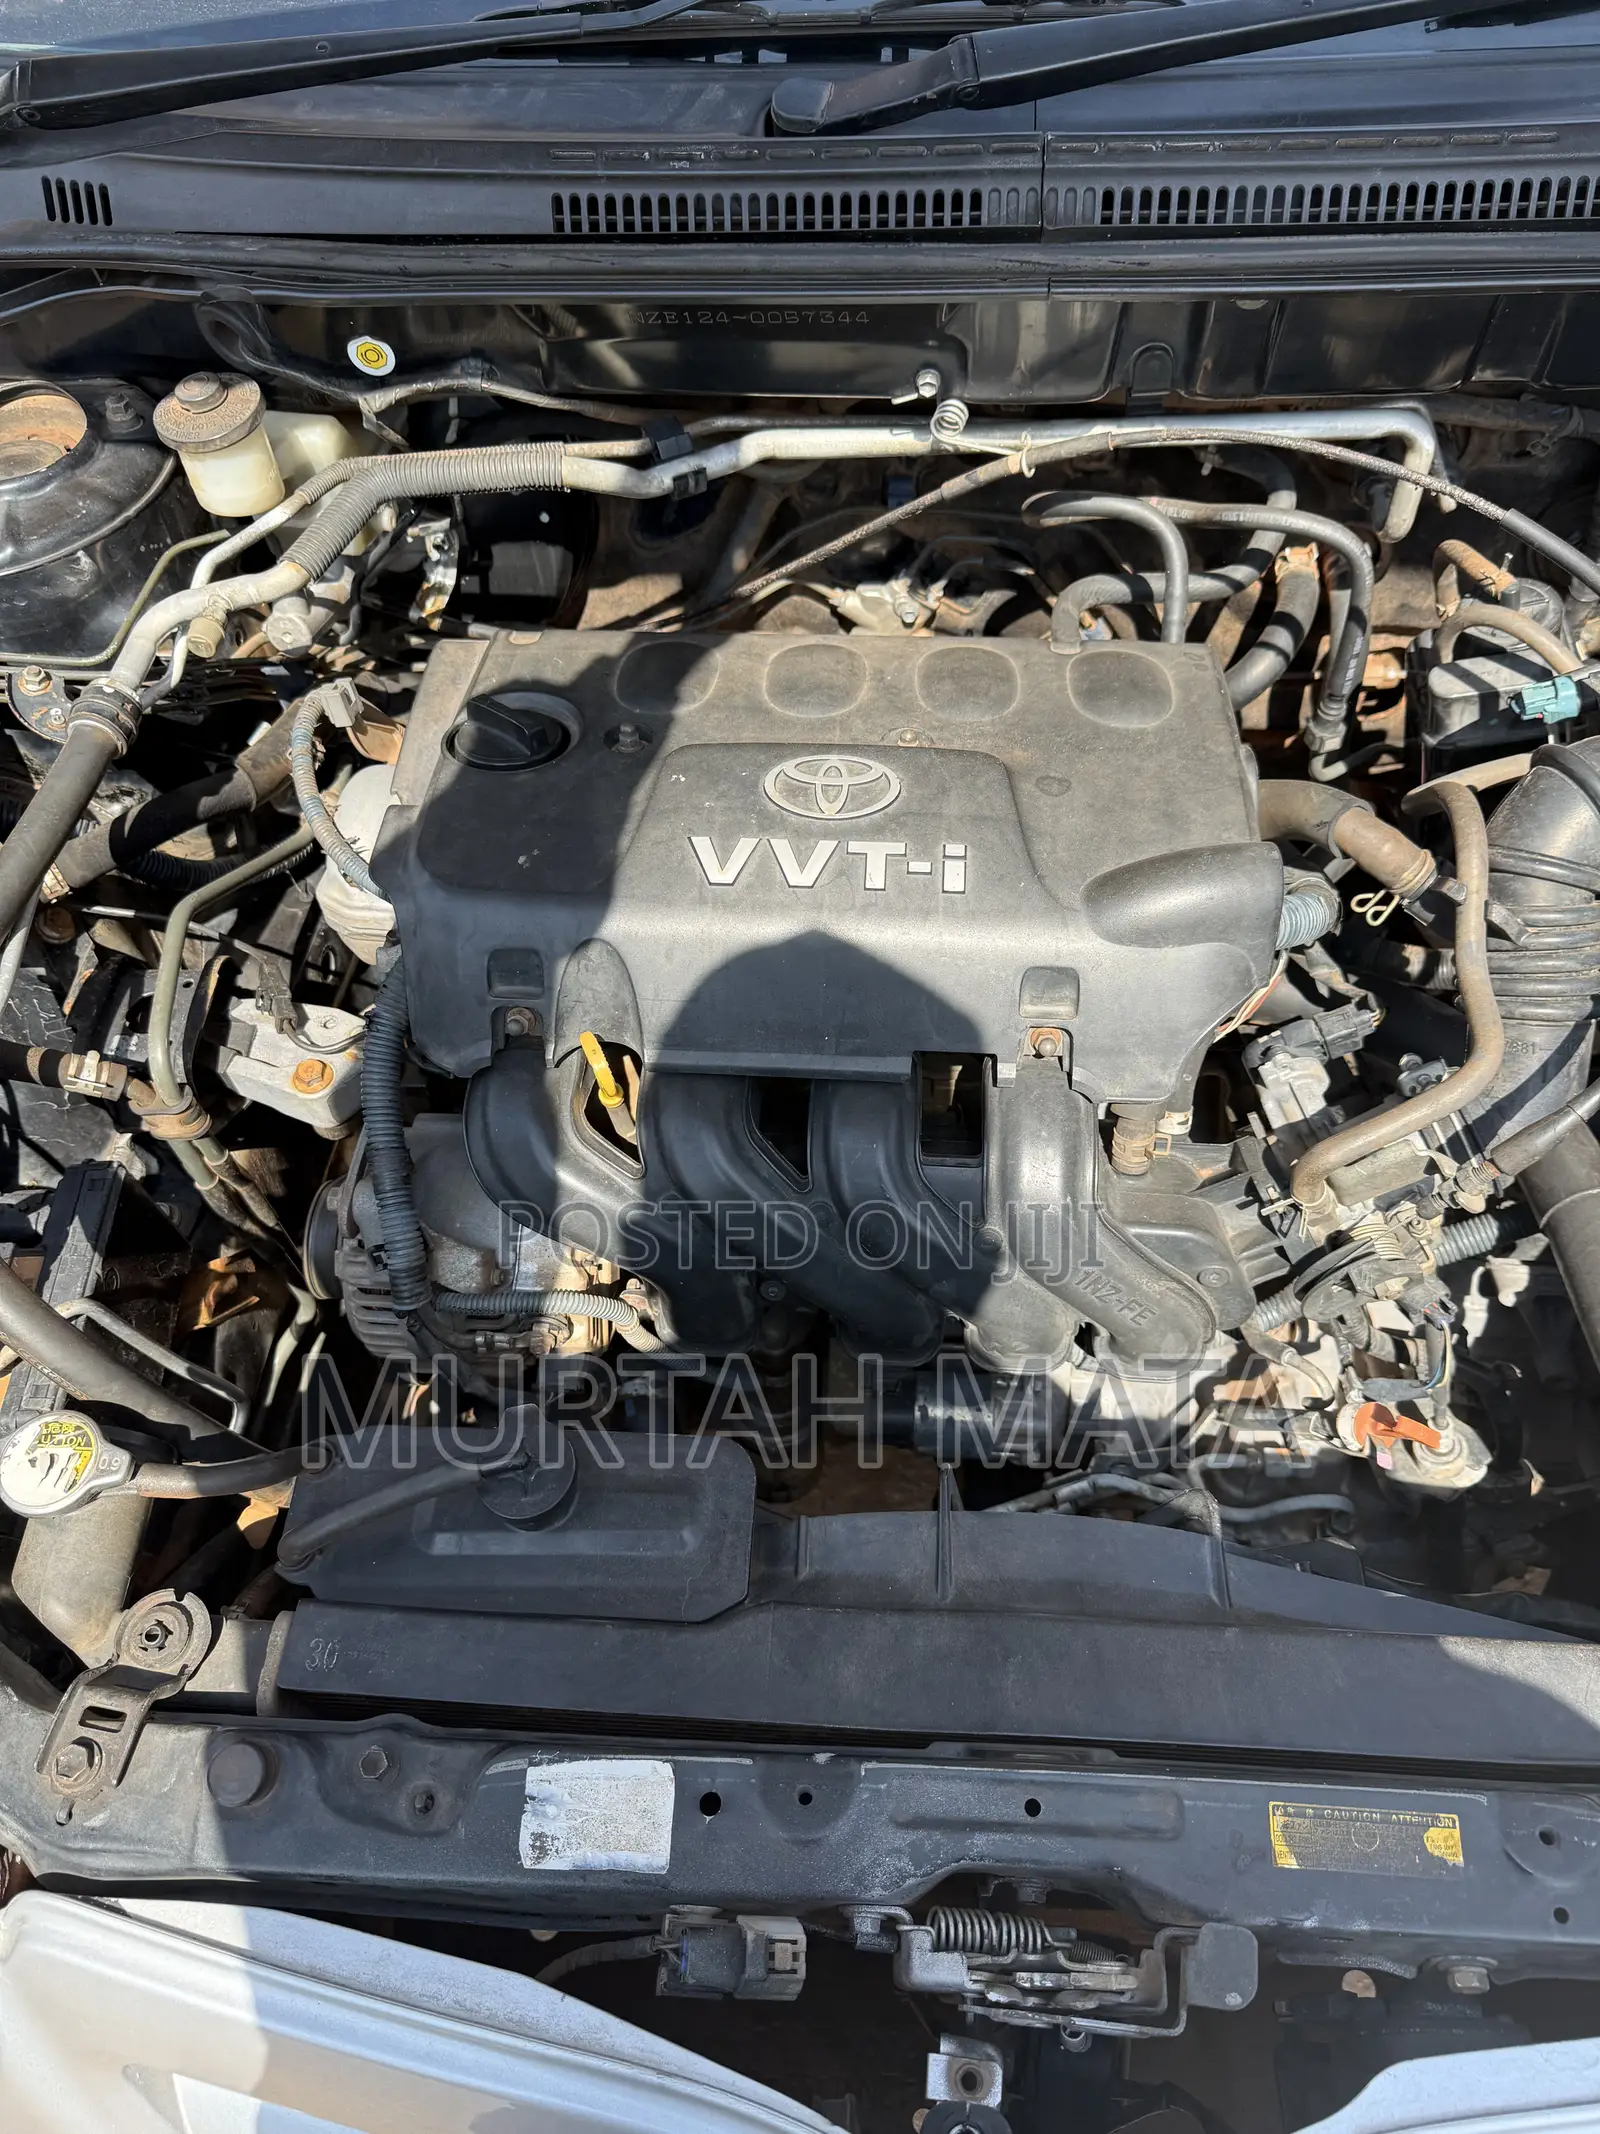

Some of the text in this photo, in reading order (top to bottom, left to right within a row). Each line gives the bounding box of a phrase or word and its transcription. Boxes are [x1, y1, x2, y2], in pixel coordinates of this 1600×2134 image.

[687, 836, 967, 894] VVT-i
[1074, 1267, 1158, 1327] 1NZ-FE
[40, 1434, 87, 1448] UTION
[1324, 1809, 1380, 1823] CAUTION
[1391, 1813, 1453, 1828] ATTENTION
